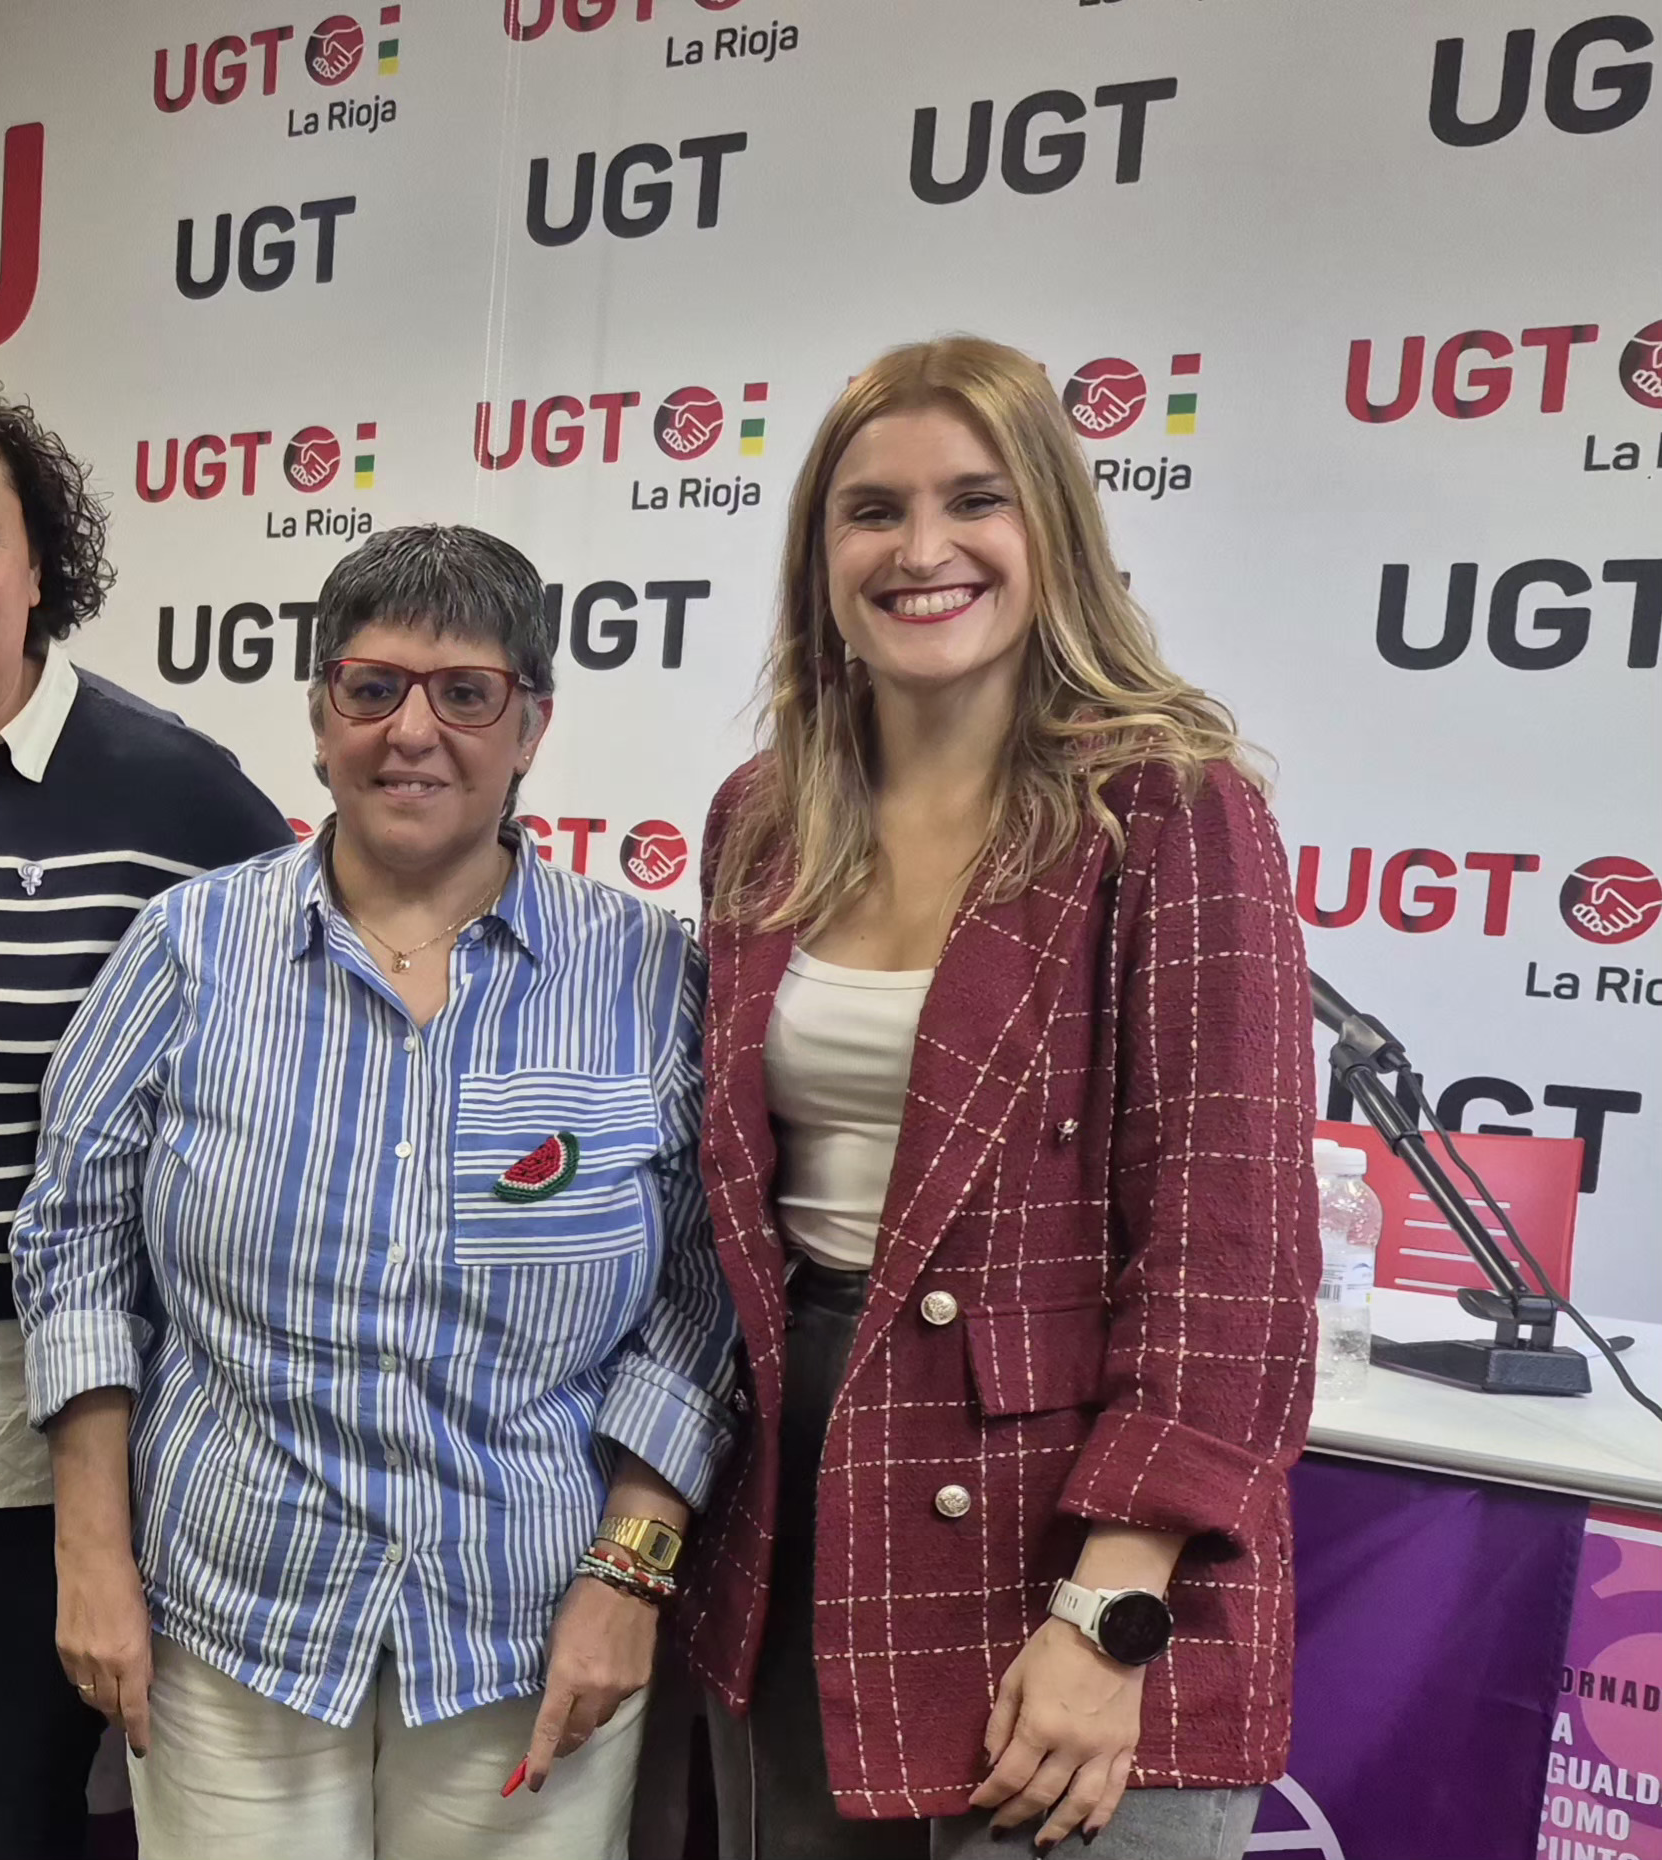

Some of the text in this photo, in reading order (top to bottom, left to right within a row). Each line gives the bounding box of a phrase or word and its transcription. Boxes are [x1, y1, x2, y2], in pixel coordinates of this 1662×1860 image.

[153, 25, 294, 113] UGT
[665, 21, 800, 68] La Rioja
[287, 95, 398, 138] La Rioja
[1429, 14, 1655, 148] UG
[909, 76, 1178, 205] UGT
[526, 131, 748, 247] UGT
[175, 195, 357, 300] UGT
[1345, 324, 1600, 424] UGT
[136, 431, 273, 503] UGT
[474, 391, 642, 471] UGT
[1584, 434, 1641, 472] La
[631, 475, 762, 515] La Rioja
[1094, 456, 1192, 501] Rioja
[266, 506, 373, 542] La Rioja
[158, 601, 319, 684] UGT
[1376, 558, 1662, 671] UGT
[1295, 844, 1541, 937] UGT
[1525, 962, 1662, 1007] La Rio
[1560, 1666, 1661, 1712] ORNAD
[1551, 1711, 1574, 1746] A
[1546, 1751, 1662, 1807] GUALD
